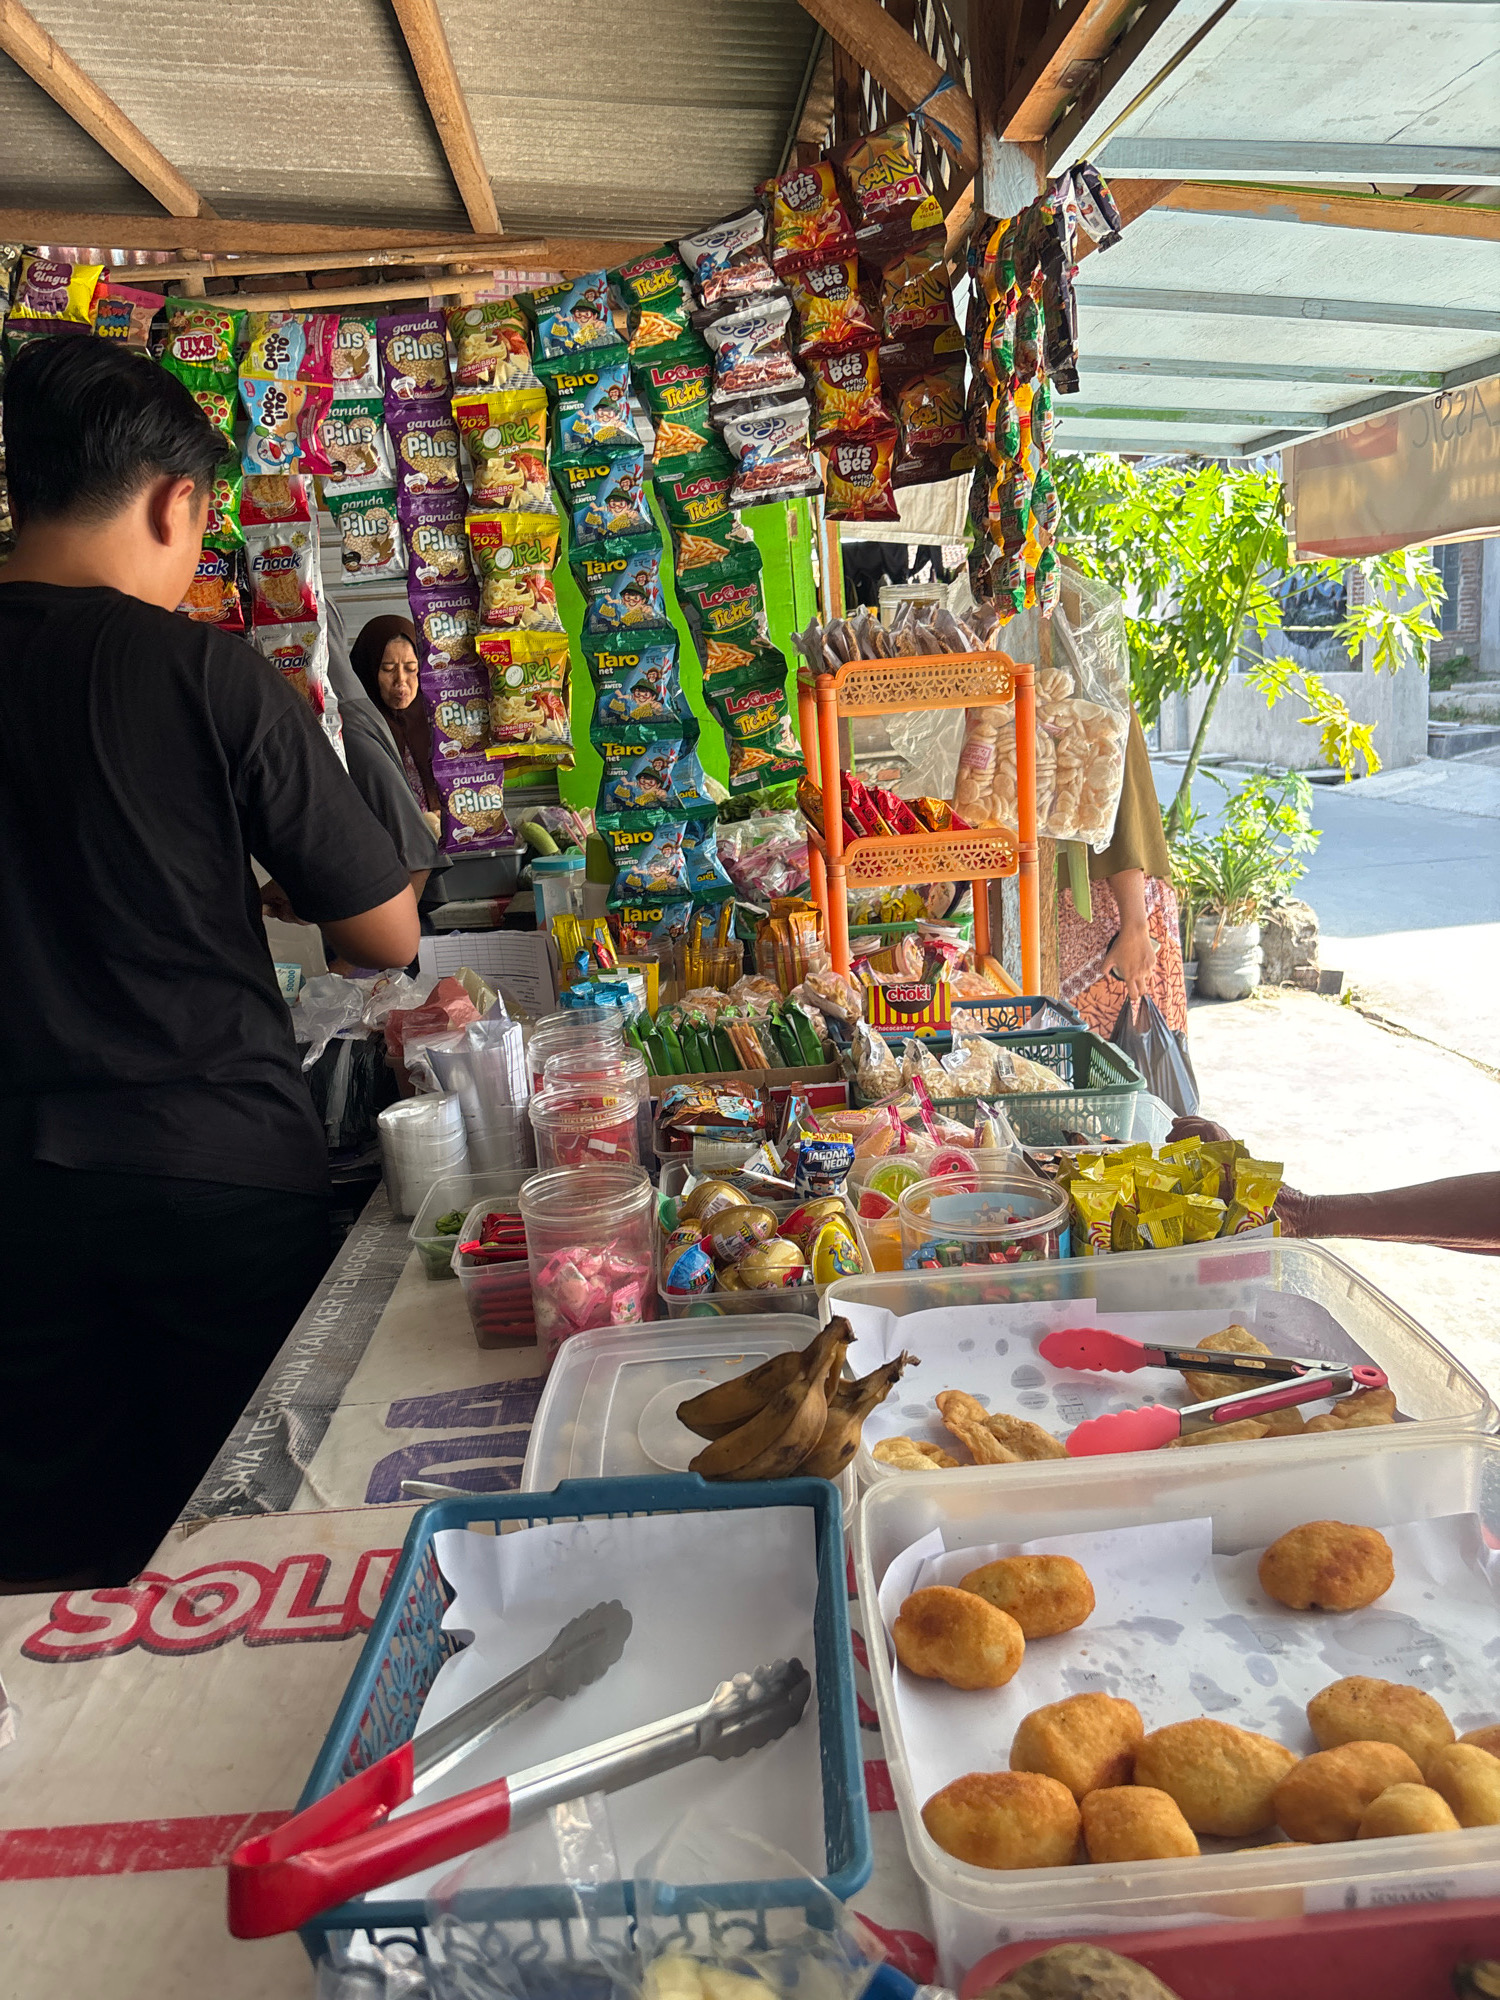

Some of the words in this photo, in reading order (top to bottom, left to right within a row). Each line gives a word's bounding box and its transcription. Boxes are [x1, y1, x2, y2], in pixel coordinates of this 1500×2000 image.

[781, 173, 815, 196] Kris
[788, 182, 817, 208] Bee
[33, 270, 69, 285] Ungu
[805, 264, 840, 282] Kris
[531, 281, 574, 299] Taro
[810, 272, 844, 293] Bee
[534, 296, 551, 305] net
[392, 319, 438, 336] garuda
[177, 333, 214, 349] BALL
[333, 331, 364, 349] lus
[180, 345, 217, 360] CHOCO
[264, 333, 280, 371] CHOCO
[392, 336, 446, 363] Pilus
[826, 352, 861, 368] Kris
[551, 373, 599, 390] Taro
[829, 363, 863, 384] Bee
[558, 387, 574, 396] net
[261, 387, 277, 427] CHOCO
[558, 403, 585, 412] SEAWEED
[406, 416, 453, 432] garuda
[736, 416, 787, 440] Gery
[321, 421, 374, 447] Pilus
[407, 432, 459, 459] Pilus
[837, 444, 873, 461] Kris
[563, 464, 611, 483] Taro
[838, 458, 872, 477] Bee
[570, 480, 586, 490] net
[341, 495, 384, 513] garuda
[340, 512, 389, 538] Pilus
[417, 510, 463, 525] garuda
[418, 528, 468, 552] Pilus
[195, 558, 229, 576] aak
[252, 553, 302, 572] Enaak
[581, 559, 628, 576] Taro
[586, 573, 603, 583] net
[427, 596, 472, 612] garuda
[483, 608, 507, 617] icken
[428, 613, 478, 639] Pilus
[593, 652, 640, 668] Taro
[598, 667, 614, 675] net
[440, 685, 484, 701] garuda
[600, 682, 623, 690] AWEED
[441, 702, 490, 728] Pilus
[602, 742, 647, 757] Taro
[605, 754, 621, 762] net
[452, 771, 497, 788] garuda
[454, 789, 503, 815] Pilus
[608, 830, 655, 846] Taro
[613, 845, 630, 853] net
[697, 872, 718, 883] Taro
[619, 905, 664, 923] Taro
[886, 986, 931, 1002] choki
[807, 1149, 848, 1164] JAGOAN
[823, 1158, 850, 1171] NEON
[212, 1446, 272, 1502] SAYA
[296, 1297, 350, 1360] KANKER
